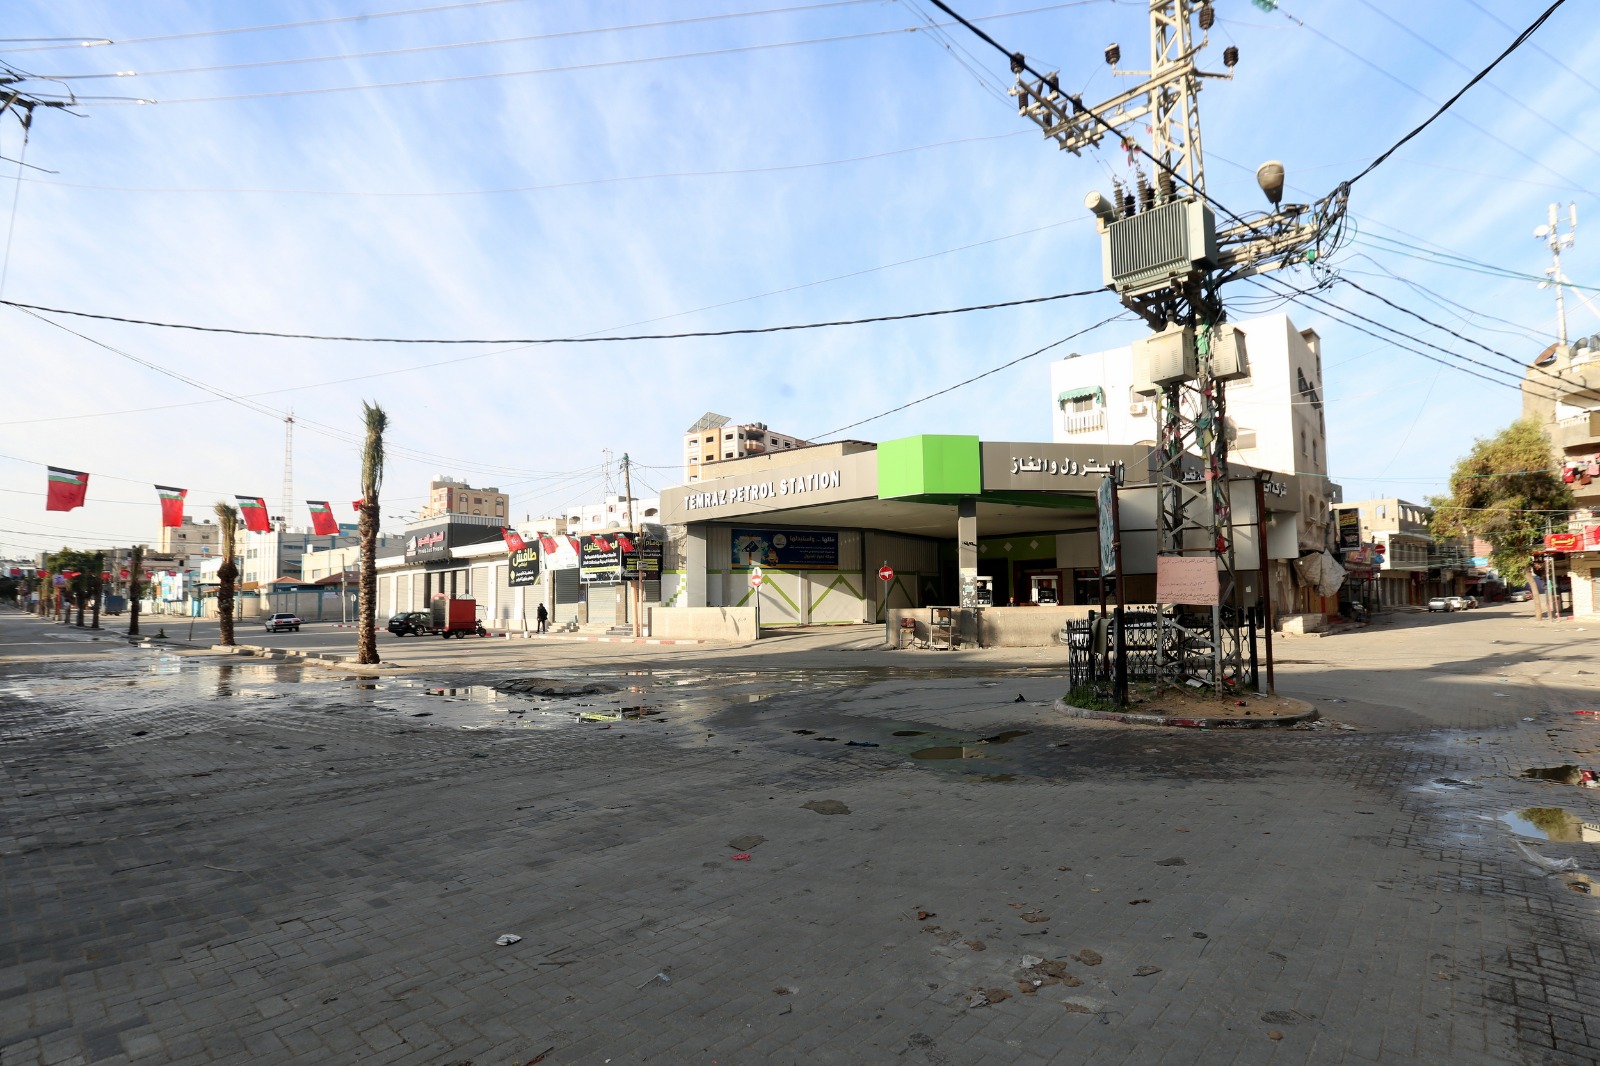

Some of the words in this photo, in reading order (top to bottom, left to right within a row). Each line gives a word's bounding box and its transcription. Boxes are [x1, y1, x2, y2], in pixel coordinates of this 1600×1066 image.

[1010, 455, 1059, 475] والغاز
[684, 489, 727, 510] TEMRAZ
[729, 482, 776, 504] PETROL
[779, 469, 841, 496] STATION
